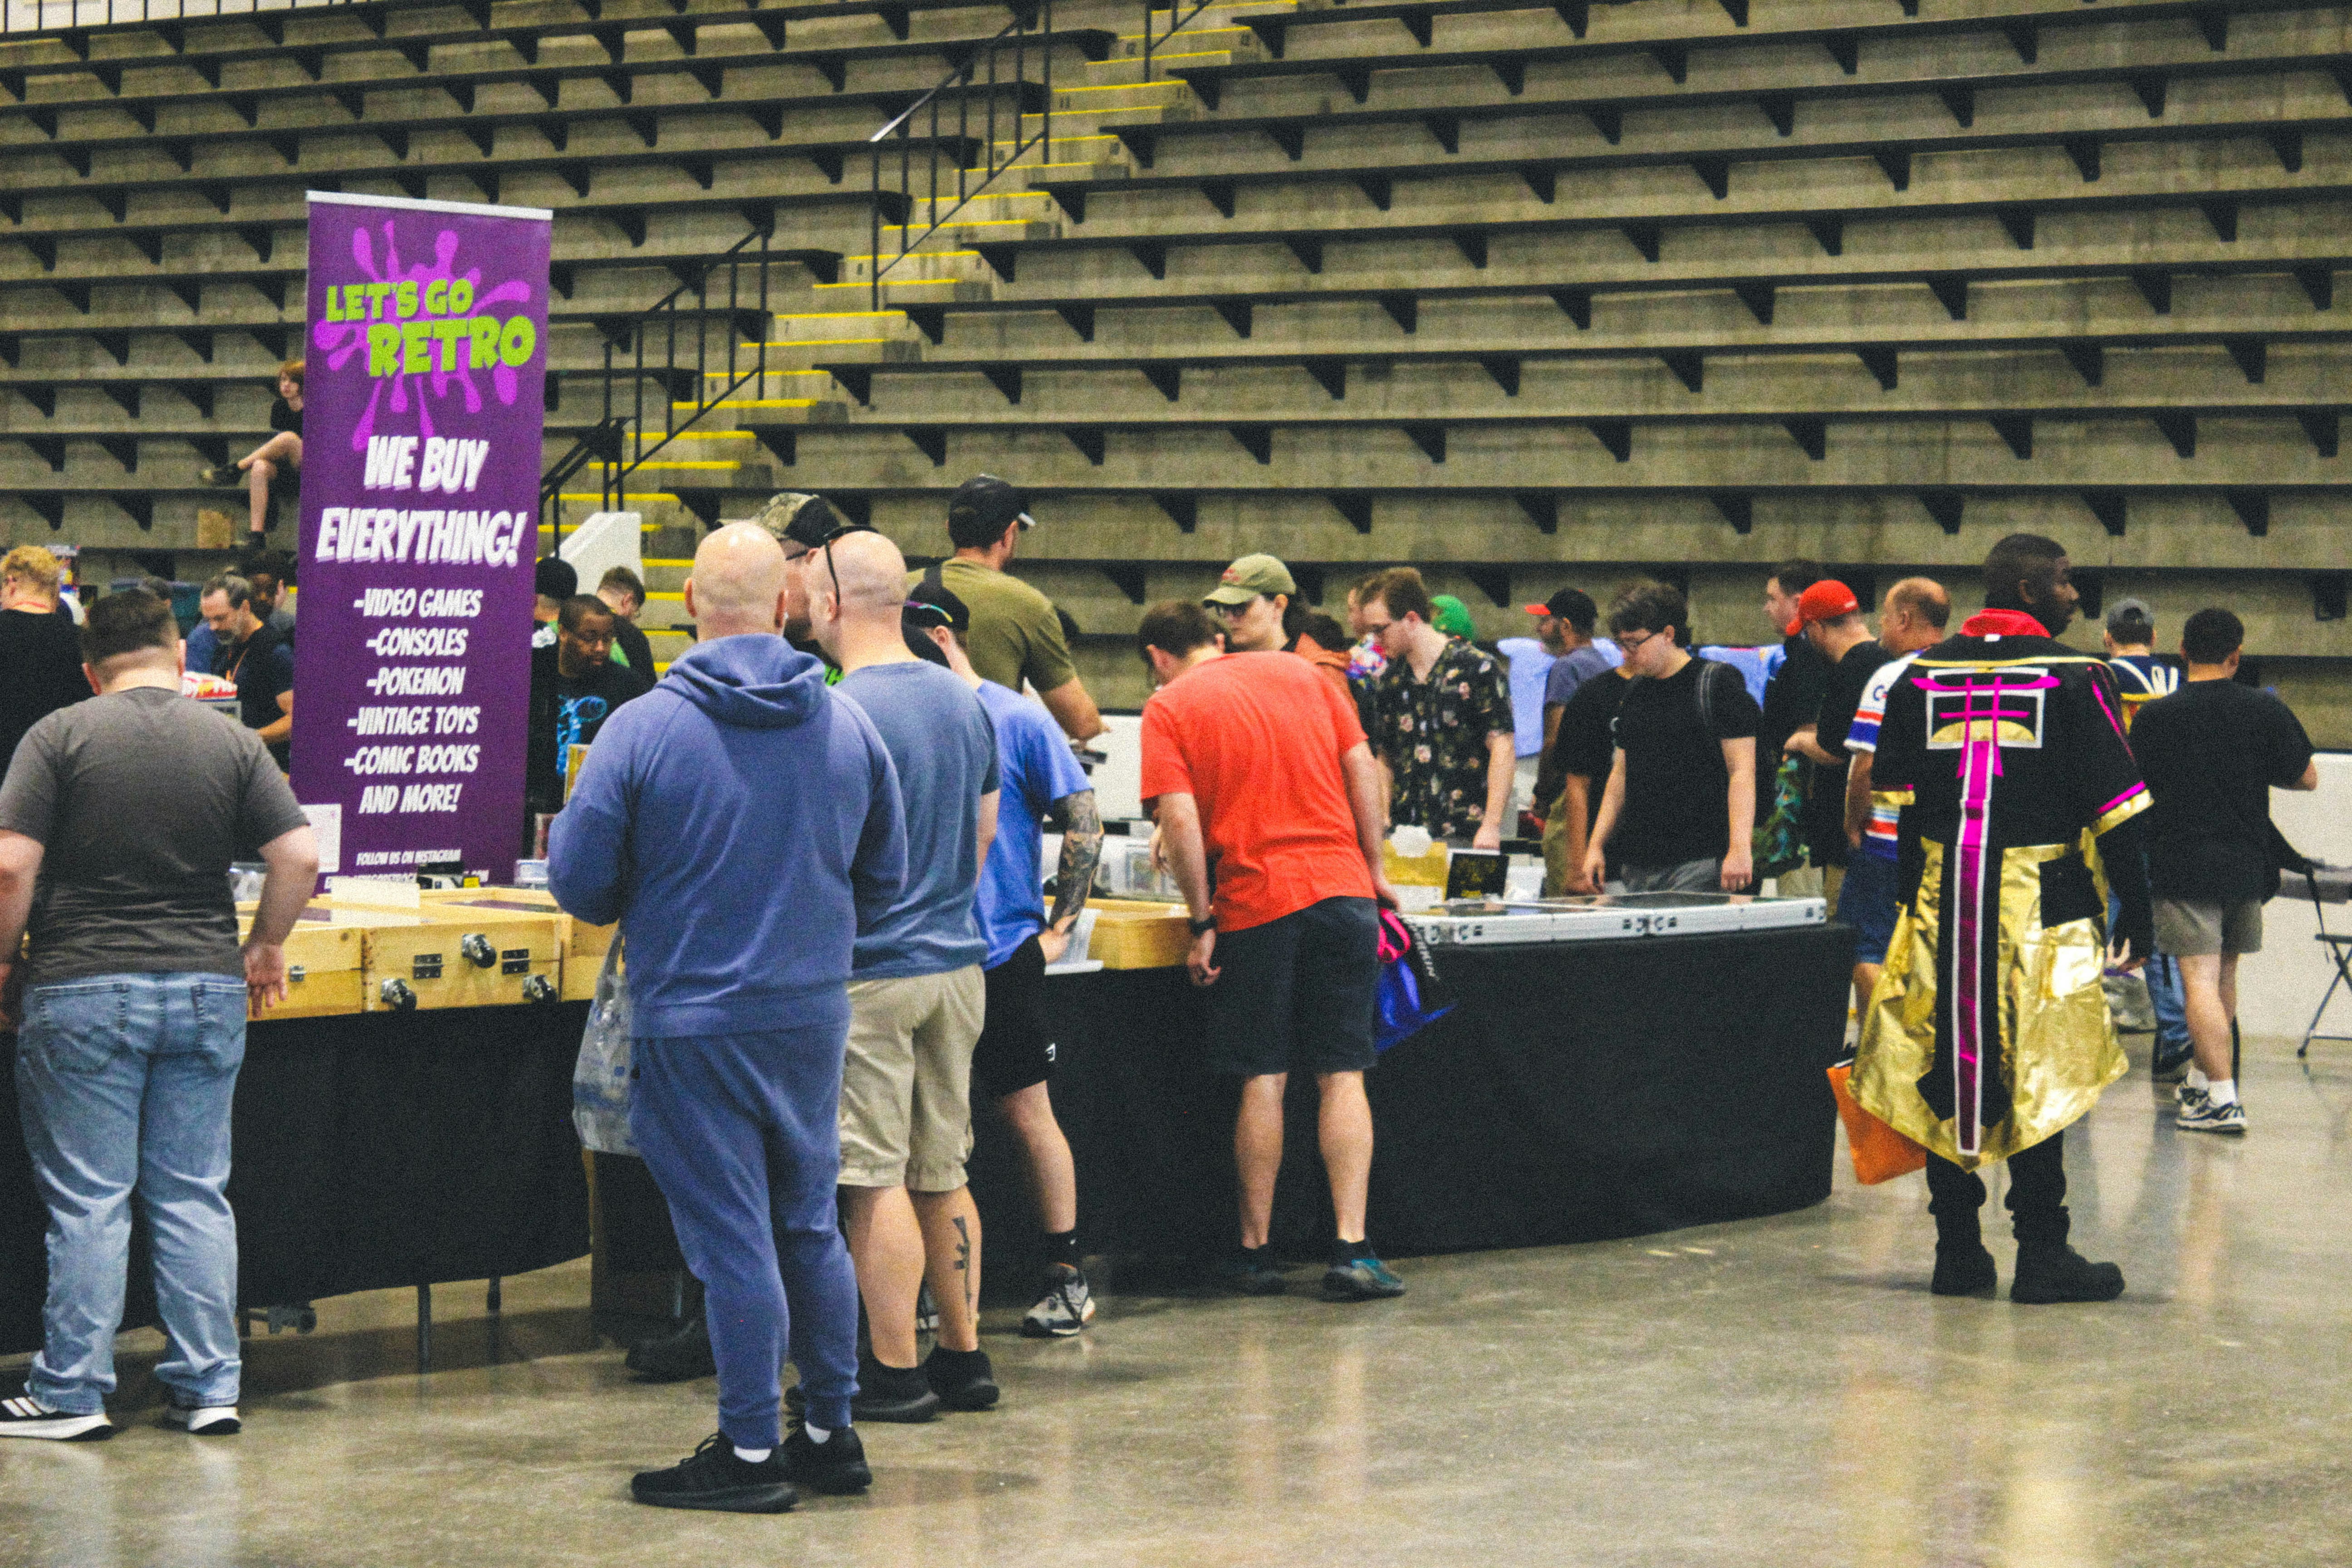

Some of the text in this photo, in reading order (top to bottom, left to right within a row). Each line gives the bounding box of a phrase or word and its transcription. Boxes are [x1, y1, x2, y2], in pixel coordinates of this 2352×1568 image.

[326, 279, 474, 321] LET'S GO
[368, 316, 536, 377] RETRO
[364, 436, 489, 492] WE BUY
[316, 507, 527, 566] EVERYTHING!
[419, 588, 483, 617] GAMES
[435, 706, 480, 734] TOYS
[416, 745, 480, 773] BOOKS
[359, 784, 462, 813] AND MORE!
[357, 849, 461, 865] FOLLOW US ON INSTAGRAM
